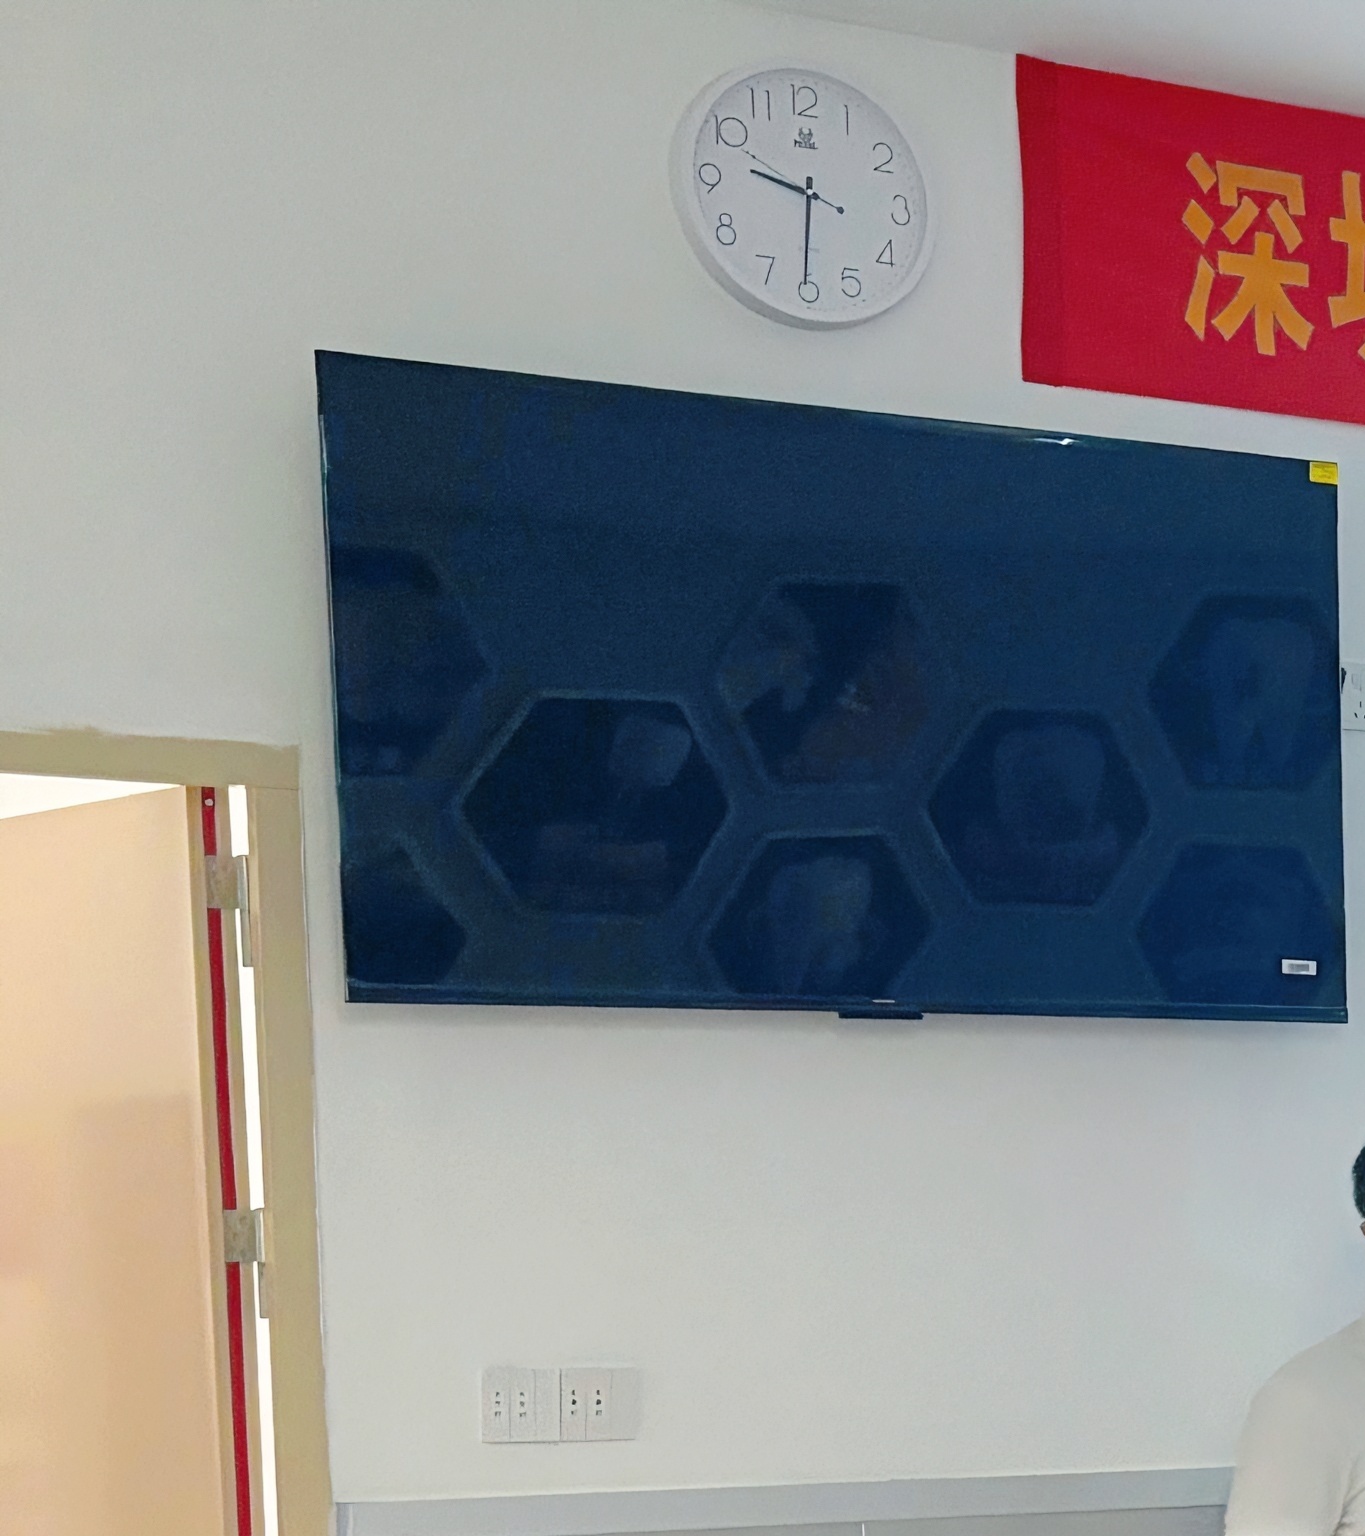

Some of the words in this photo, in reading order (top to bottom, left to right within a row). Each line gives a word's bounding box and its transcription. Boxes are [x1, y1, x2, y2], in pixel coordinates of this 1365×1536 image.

[750, 87, 771, 121] 11
[790, 83, 818, 118] 12
[714, 113, 748, 147] 10
[843, 103, 850, 136] 1
[872, 142, 894, 173] 2
[698, 162, 722, 194] 9
[891, 194, 911, 226] 3
[715, 212, 737, 245] 8
[875, 239, 896, 267] 4
[755, 254, 776, 285] 7
[841, 267, 862, 298] 5
[798, 273, 820, 303] 6
